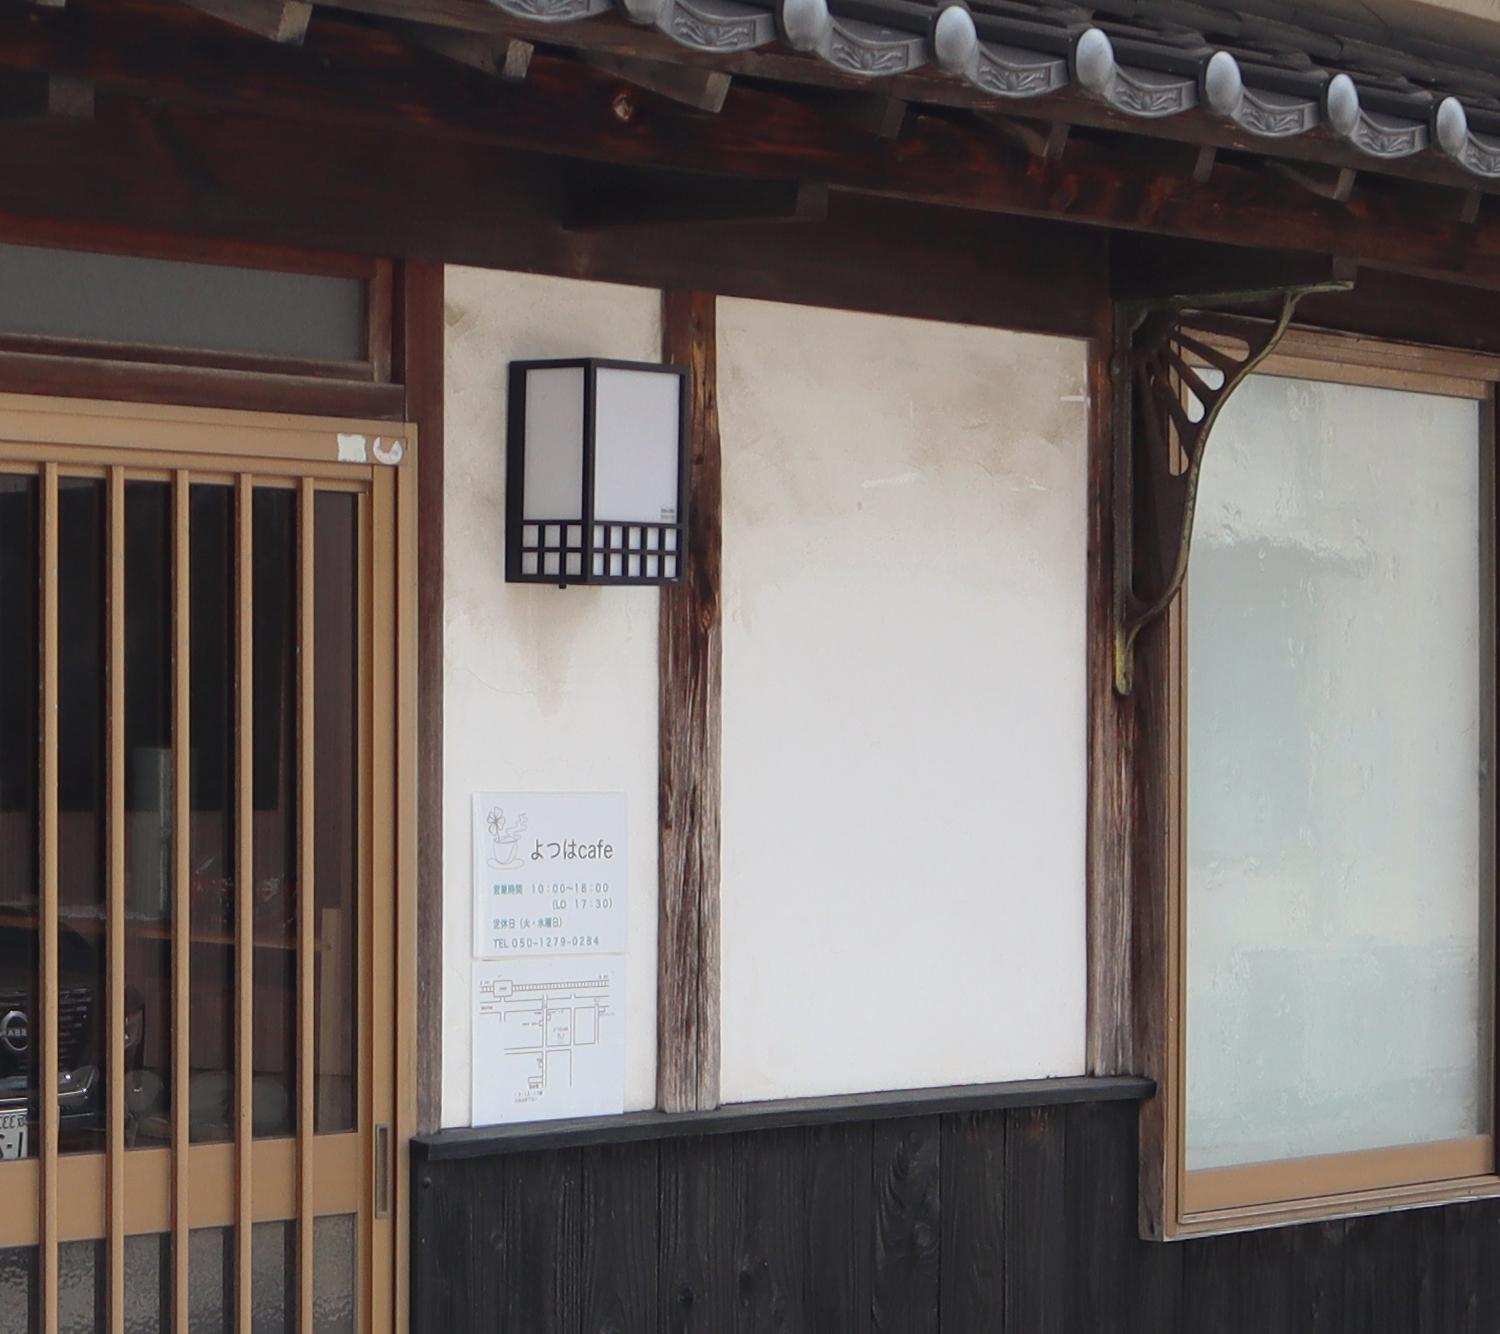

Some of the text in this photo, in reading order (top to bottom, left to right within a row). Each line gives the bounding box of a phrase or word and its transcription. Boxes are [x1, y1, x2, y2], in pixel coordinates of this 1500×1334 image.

[530, 838, 613, 860] よつはcafe
[493, 936, 600, 949] TEL 050-1279-0284
